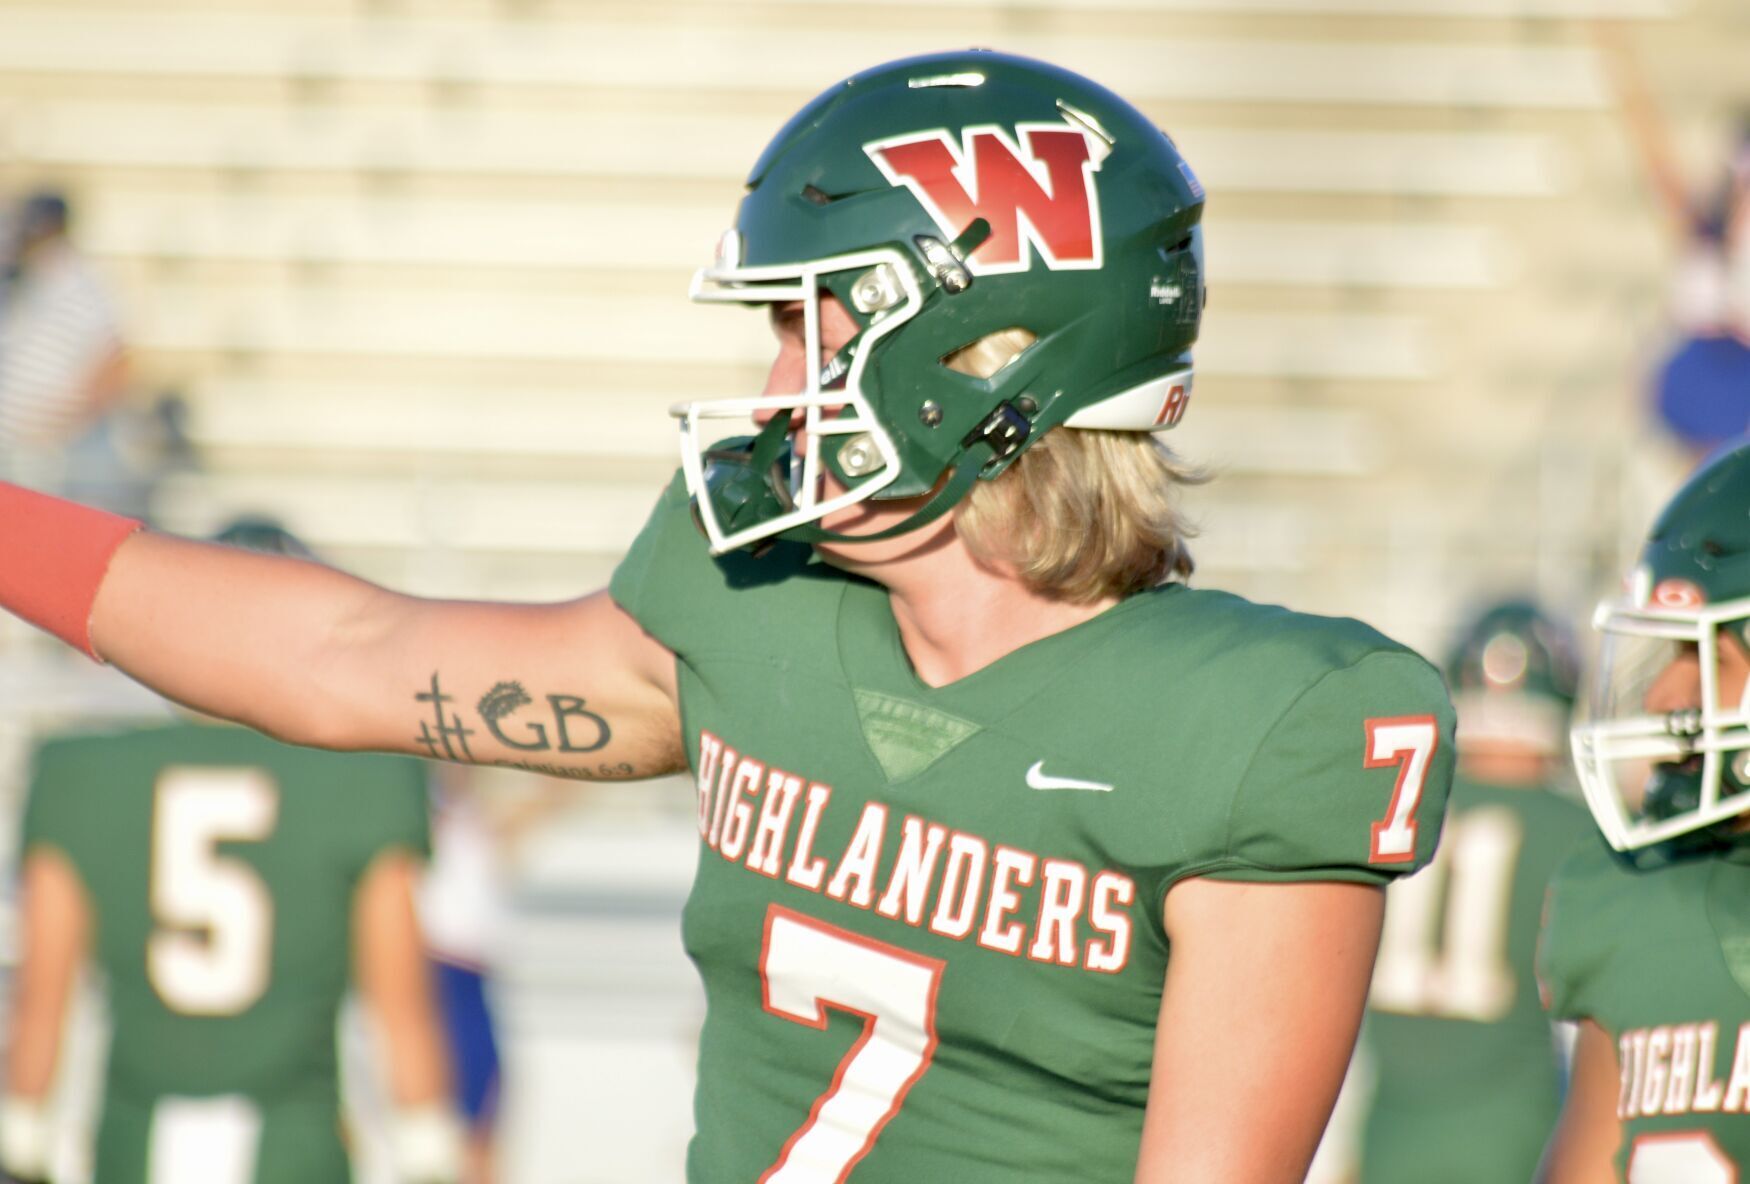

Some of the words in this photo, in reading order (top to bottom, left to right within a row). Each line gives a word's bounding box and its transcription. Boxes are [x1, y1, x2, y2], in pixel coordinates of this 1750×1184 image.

[862, 122, 1105, 276] W
[146, 763, 280, 1018] 5
[697, 728, 1135, 974] HIGHLANDERS
[1363, 715, 1437, 864] 7
[757, 903, 947, 1184] 7
